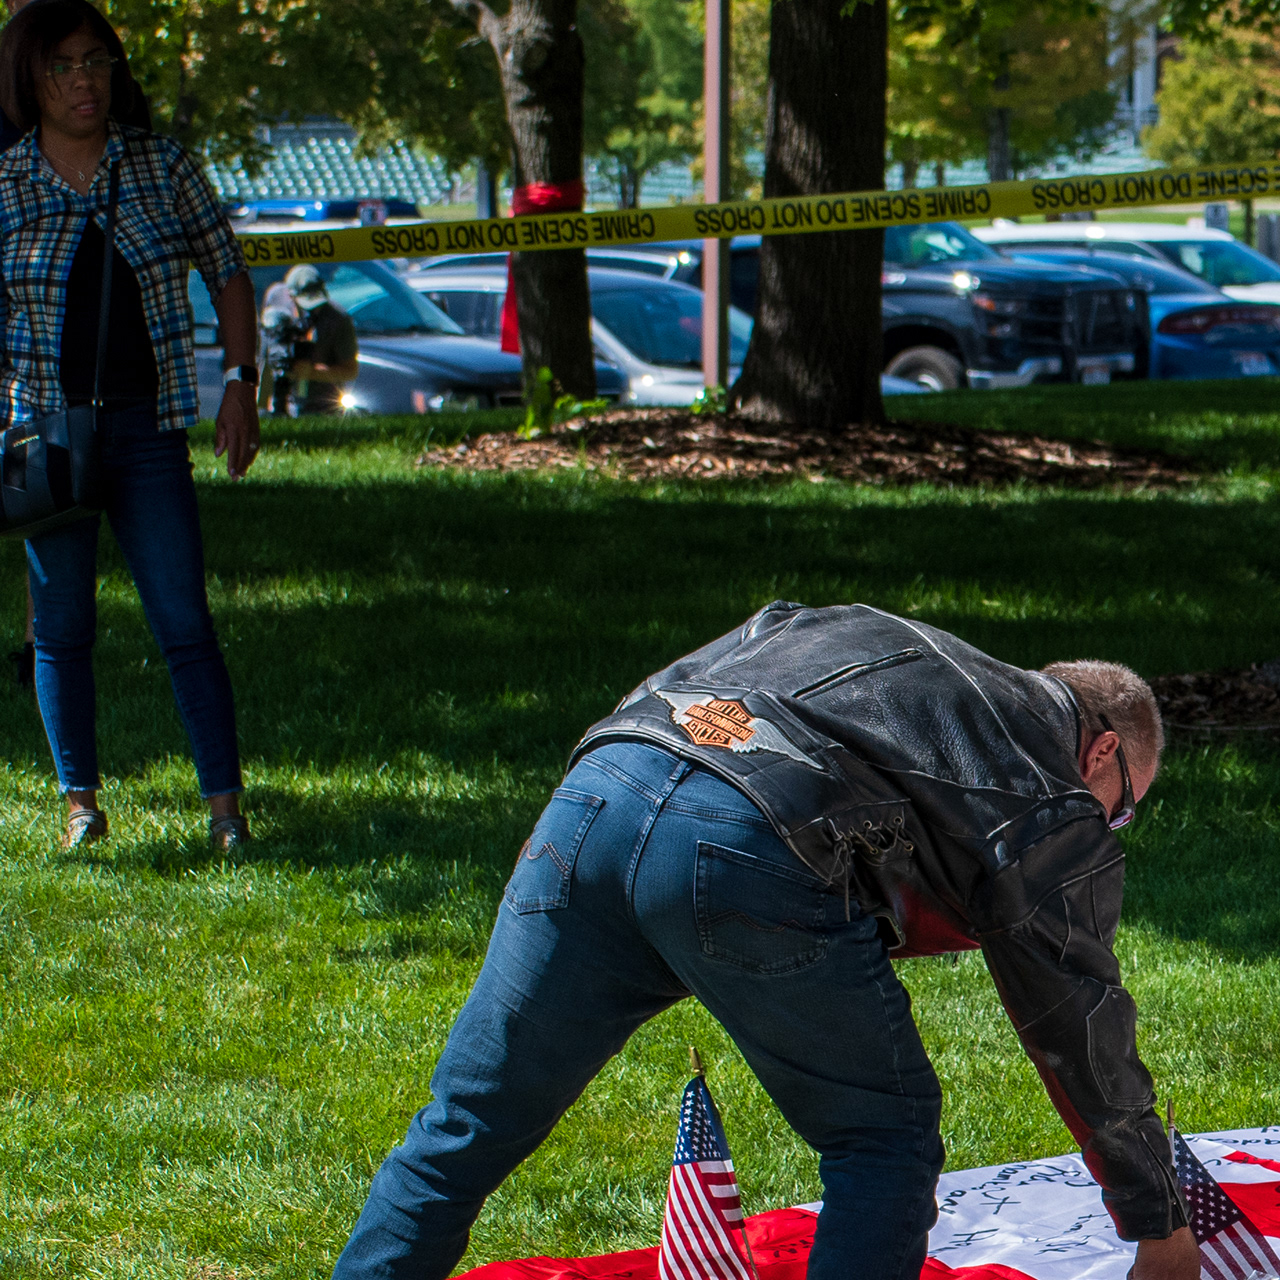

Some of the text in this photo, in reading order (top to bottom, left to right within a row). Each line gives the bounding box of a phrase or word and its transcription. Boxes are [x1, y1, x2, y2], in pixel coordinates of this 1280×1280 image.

[1032, 179, 1106, 210] CROSS
[1115, 175, 1155, 200] NOT
[1160, 171, 1191, 199] DO
[1199, 166, 1268, 196] SCENE
[695, 188, 991, 235] CRIME SCENE DO NOT CROSS
[272, 233, 335, 260] CRIME
[371, 213, 656, 255] CRIME SCENE DO NOT CROSS
[707, 700, 747, 723] MOTOR
[689, 720, 729, 743] CYCLES
